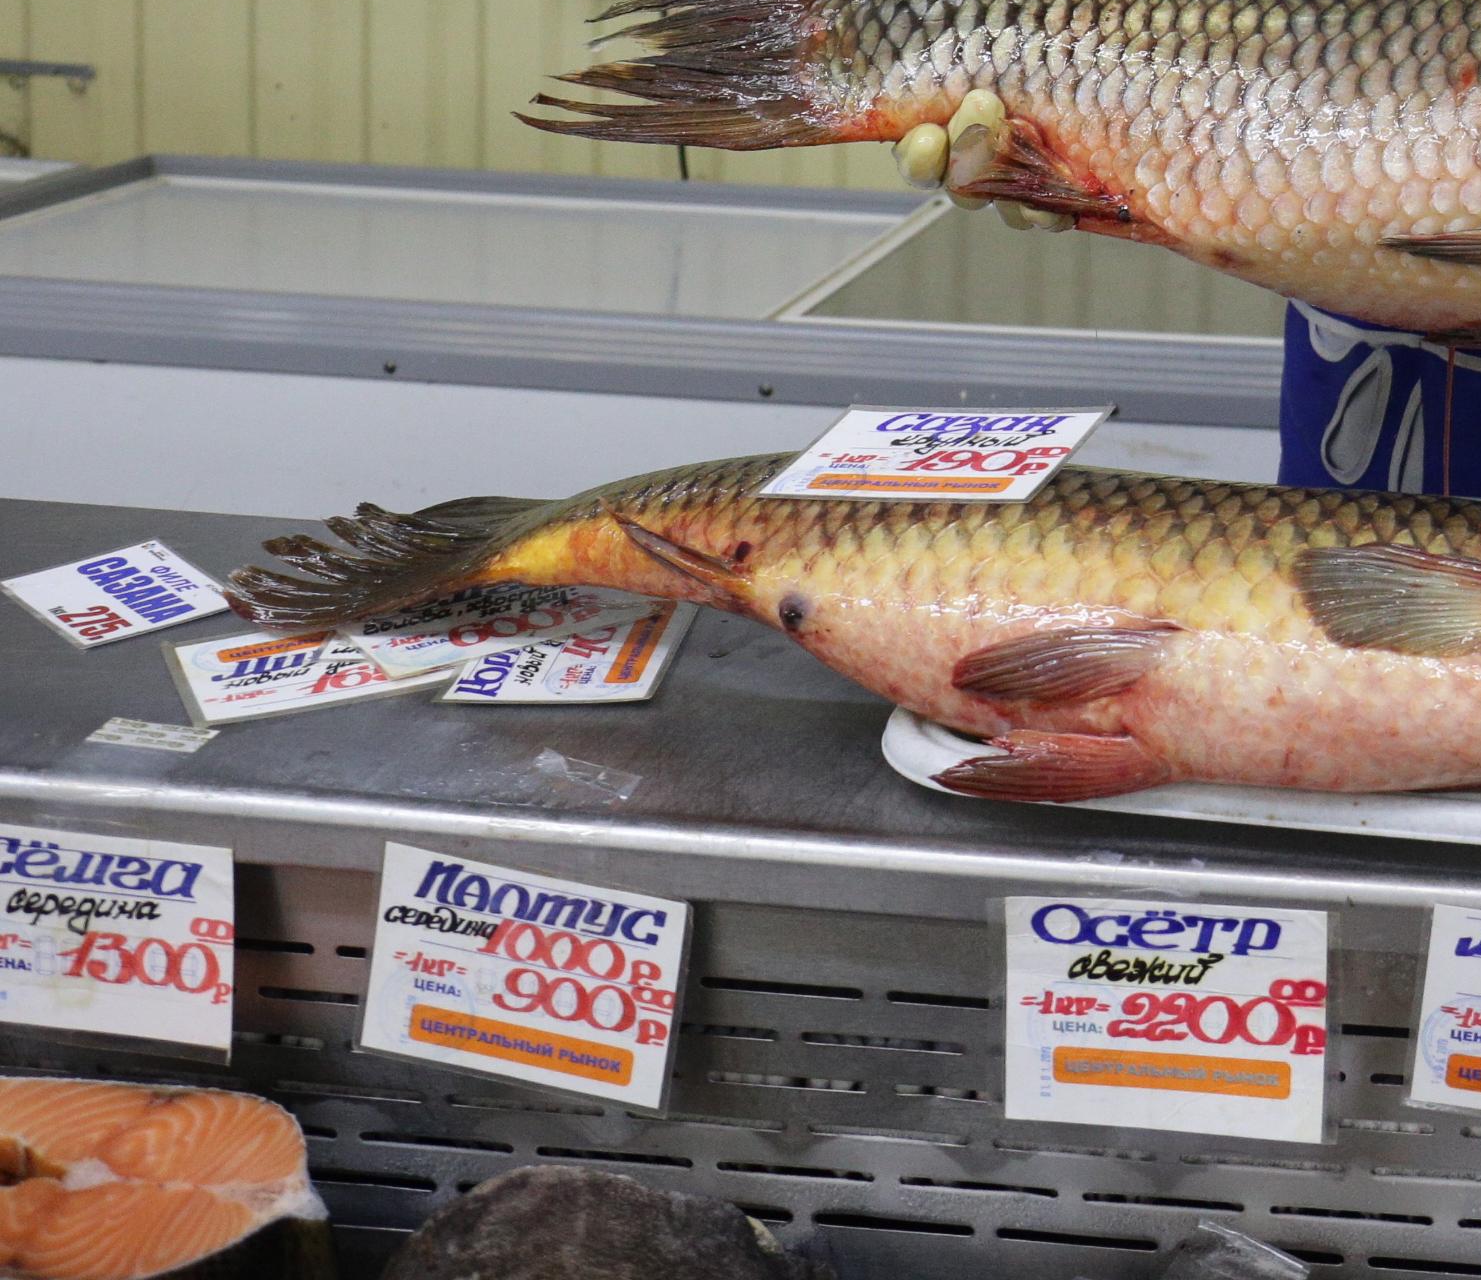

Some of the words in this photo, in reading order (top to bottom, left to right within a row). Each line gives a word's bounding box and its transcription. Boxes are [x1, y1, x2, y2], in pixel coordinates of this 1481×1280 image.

[876, 413, 1075, 442] Сазан
[818, 478, 941, 489] ЦЕНТРАЛЬНЫЙ
[944, 480, 1000, 489] РЫНОК
[77, 556, 196, 624] САЗАНА
[150, 565, 200, 593] ФИЛЕ
[6, 888, 162, 936] середина
[1031, 904, 1283, 956] Осётр
[477, 918, 627, 981] 1000
[1067, 949, 1224, 984] свежий
[414, 977, 463, 998] ЦЕНА:
[491, 967, 637, 1032] 900
[1052, 1020, 1103, 1034] ЦЕНА:
[1106, 991, 1297, 1046] 2200
[419, 1018, 554, 1059] ЦЕНТРАЛЬНЫЙ
[558, 1047, 622, 1074] РЫНОК
[1064, 1059, 1206, 1082] ЦЕНТРАЛЬНЫЙ
[1212, 1072, 1279, 1087] РЫНОК
